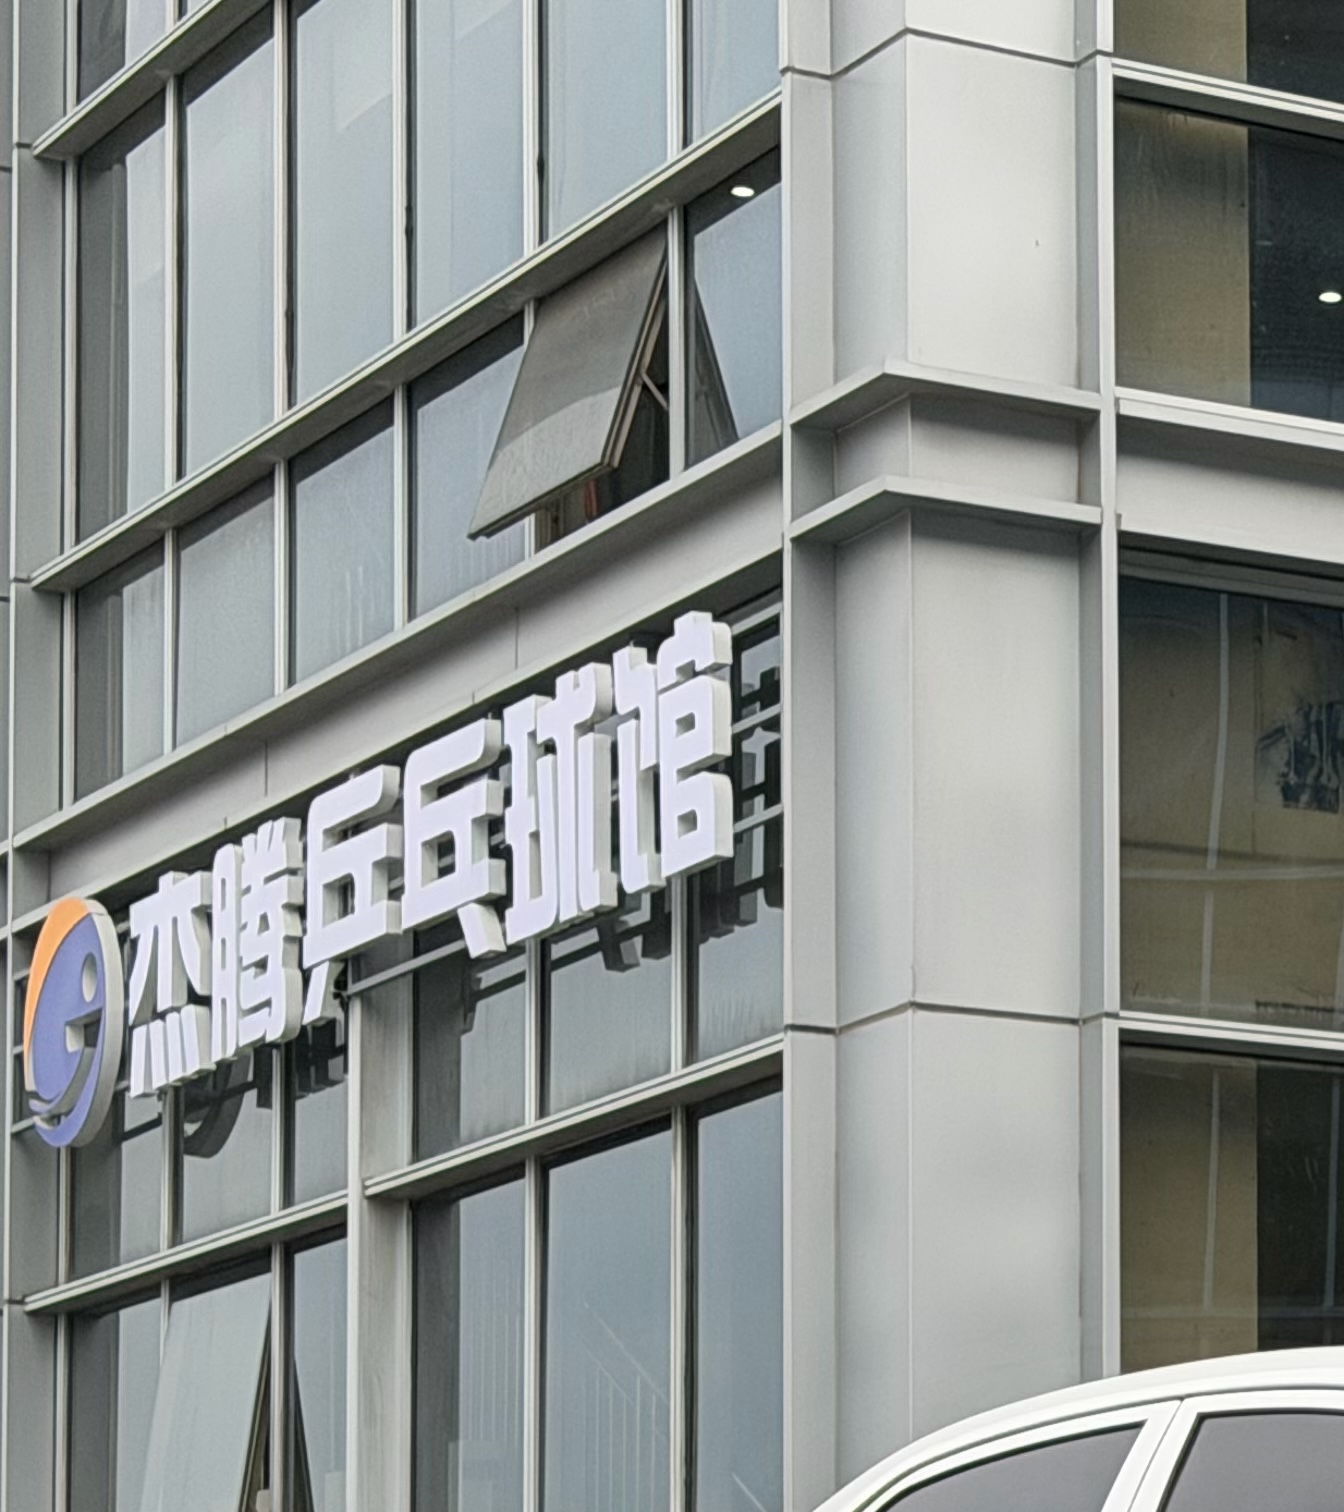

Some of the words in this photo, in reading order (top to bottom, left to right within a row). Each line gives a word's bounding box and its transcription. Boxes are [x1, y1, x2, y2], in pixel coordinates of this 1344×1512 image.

[129, 611, 734, 1099] 杰腾乒乓球馆
